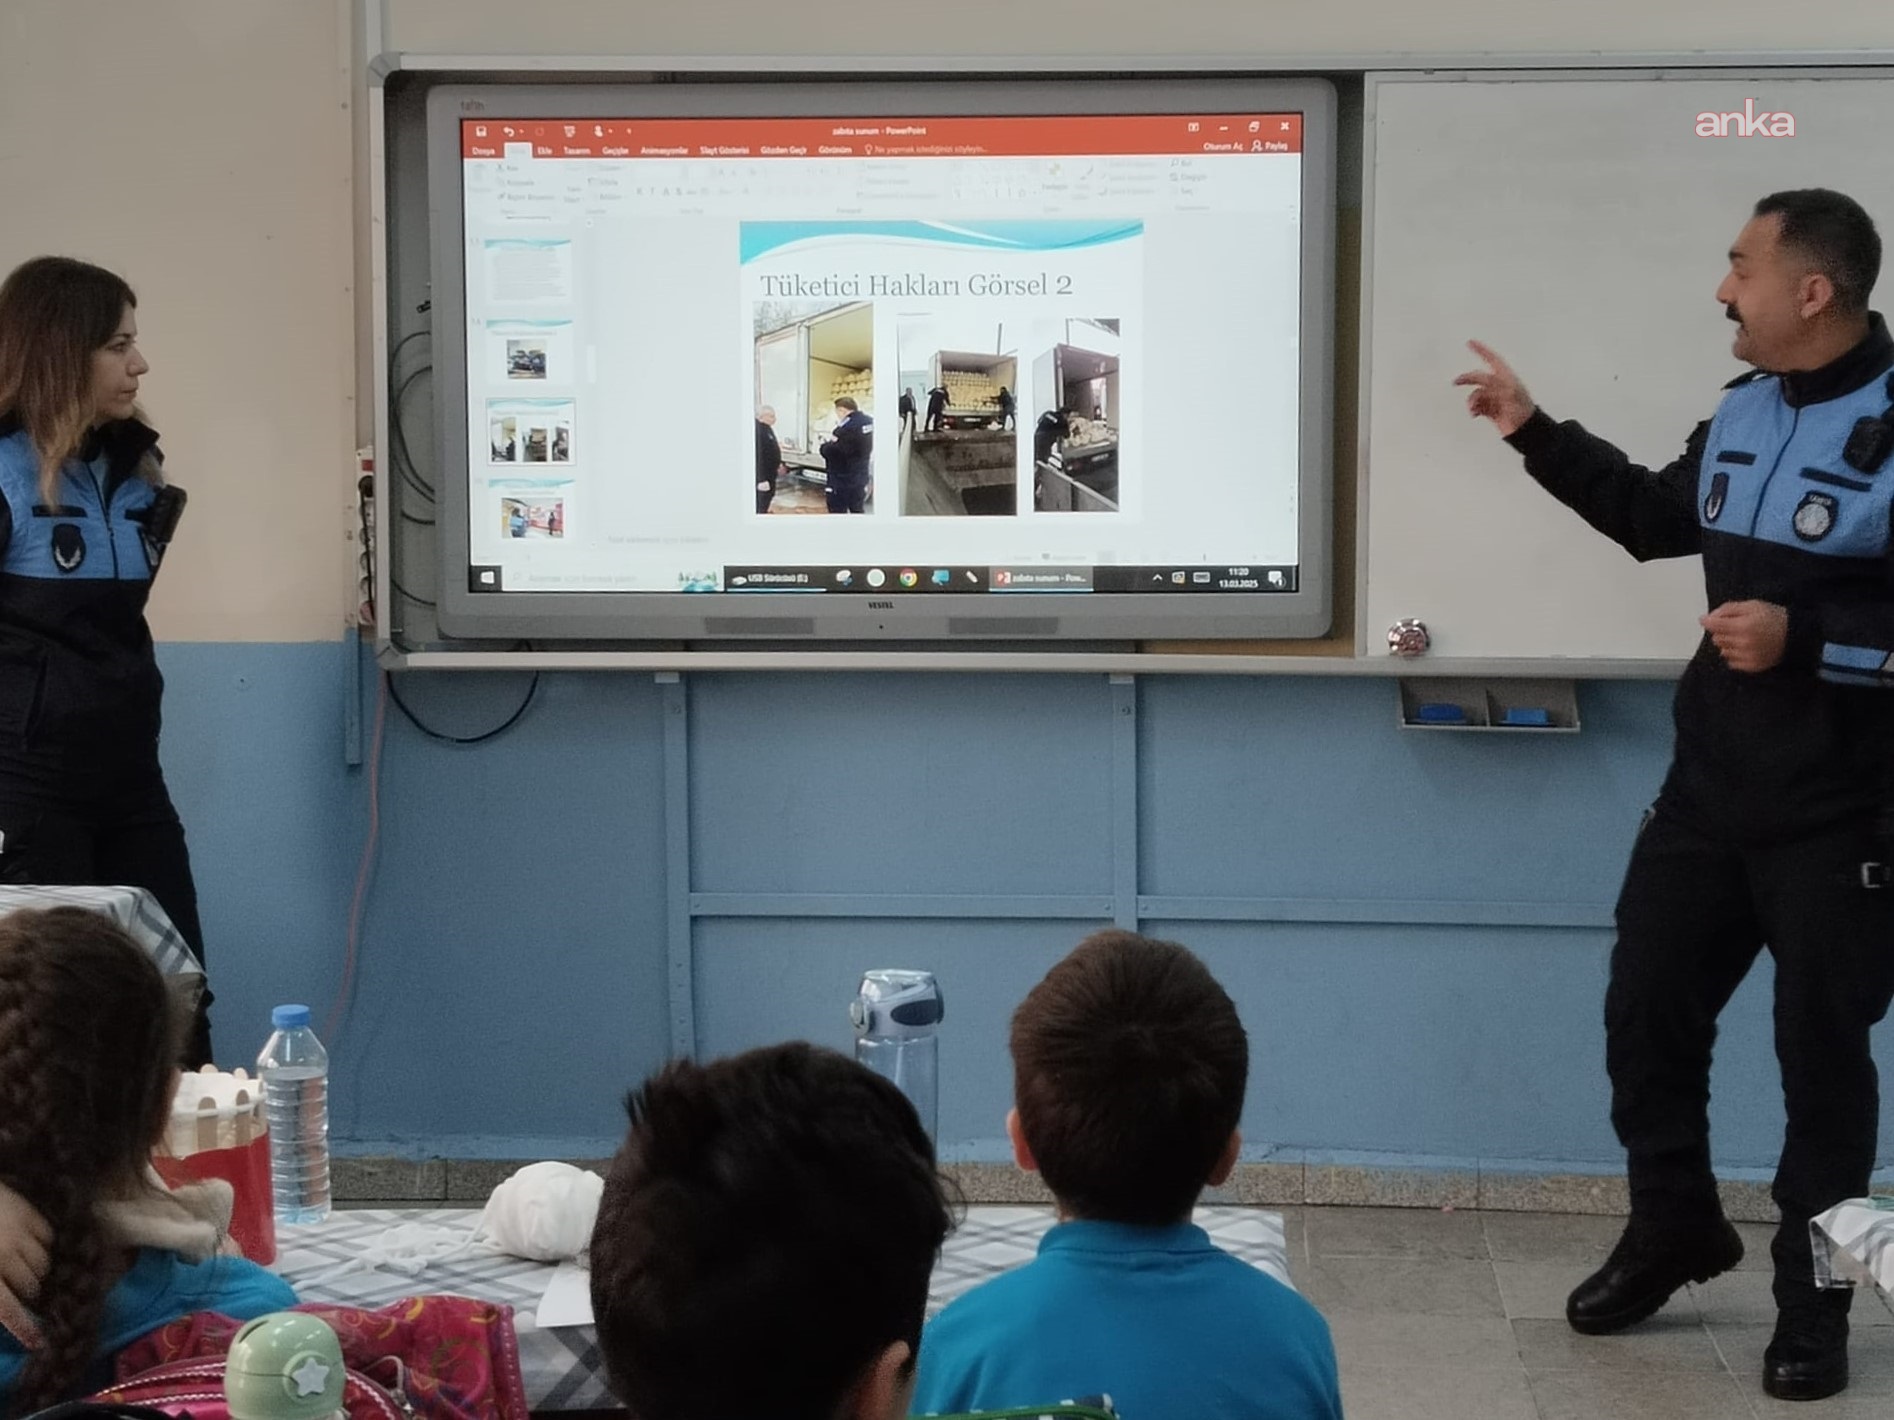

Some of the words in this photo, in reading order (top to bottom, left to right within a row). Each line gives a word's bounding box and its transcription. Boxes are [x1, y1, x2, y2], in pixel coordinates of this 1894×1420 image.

[885, 126, 927, 136] PowerPoint
[760, 273, 861, 297] Tüketici
[868, 273, 960, 297] Hakları
[967, 273, 1047, 296] Görsel
[1055, 274, 1074, 296] 2
